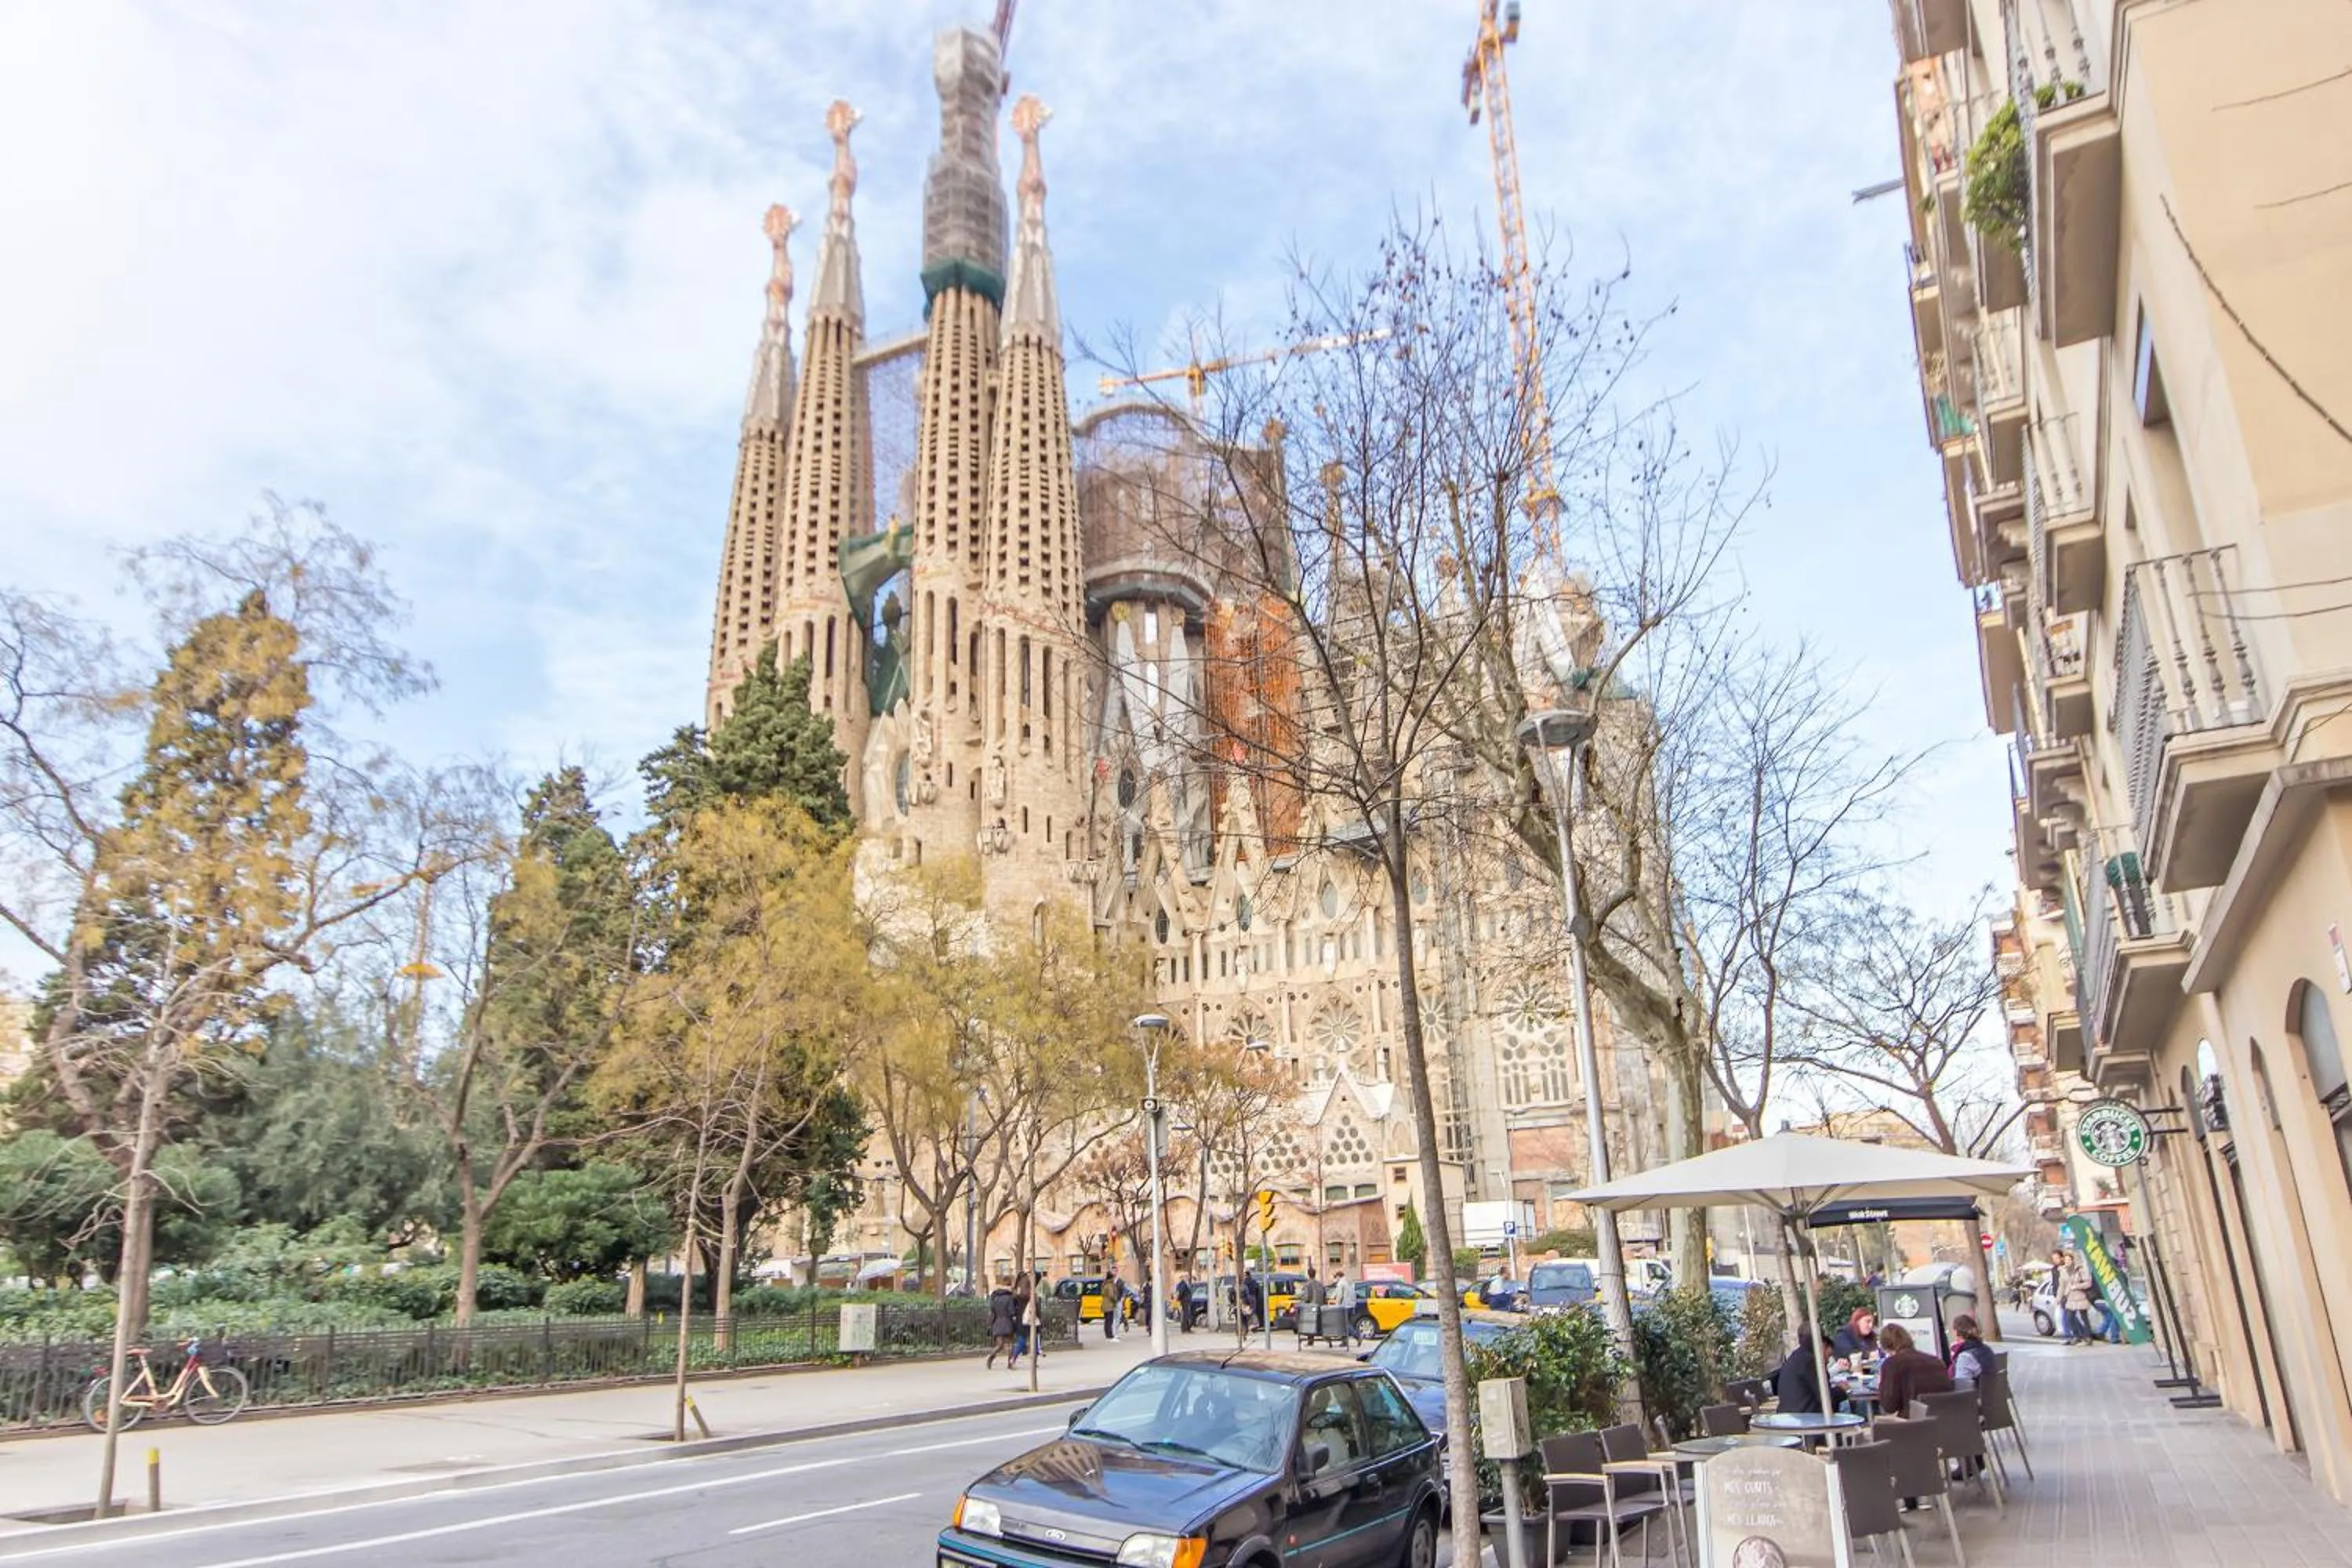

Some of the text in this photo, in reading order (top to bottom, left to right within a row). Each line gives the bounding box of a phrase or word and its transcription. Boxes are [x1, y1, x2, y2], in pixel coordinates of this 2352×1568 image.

[2082, 1109, 2138, 1135] STARBUCKS
[2092, 1146, 2137, 1164] COFFEE
[1505, 1223, 1514, 1234] P
